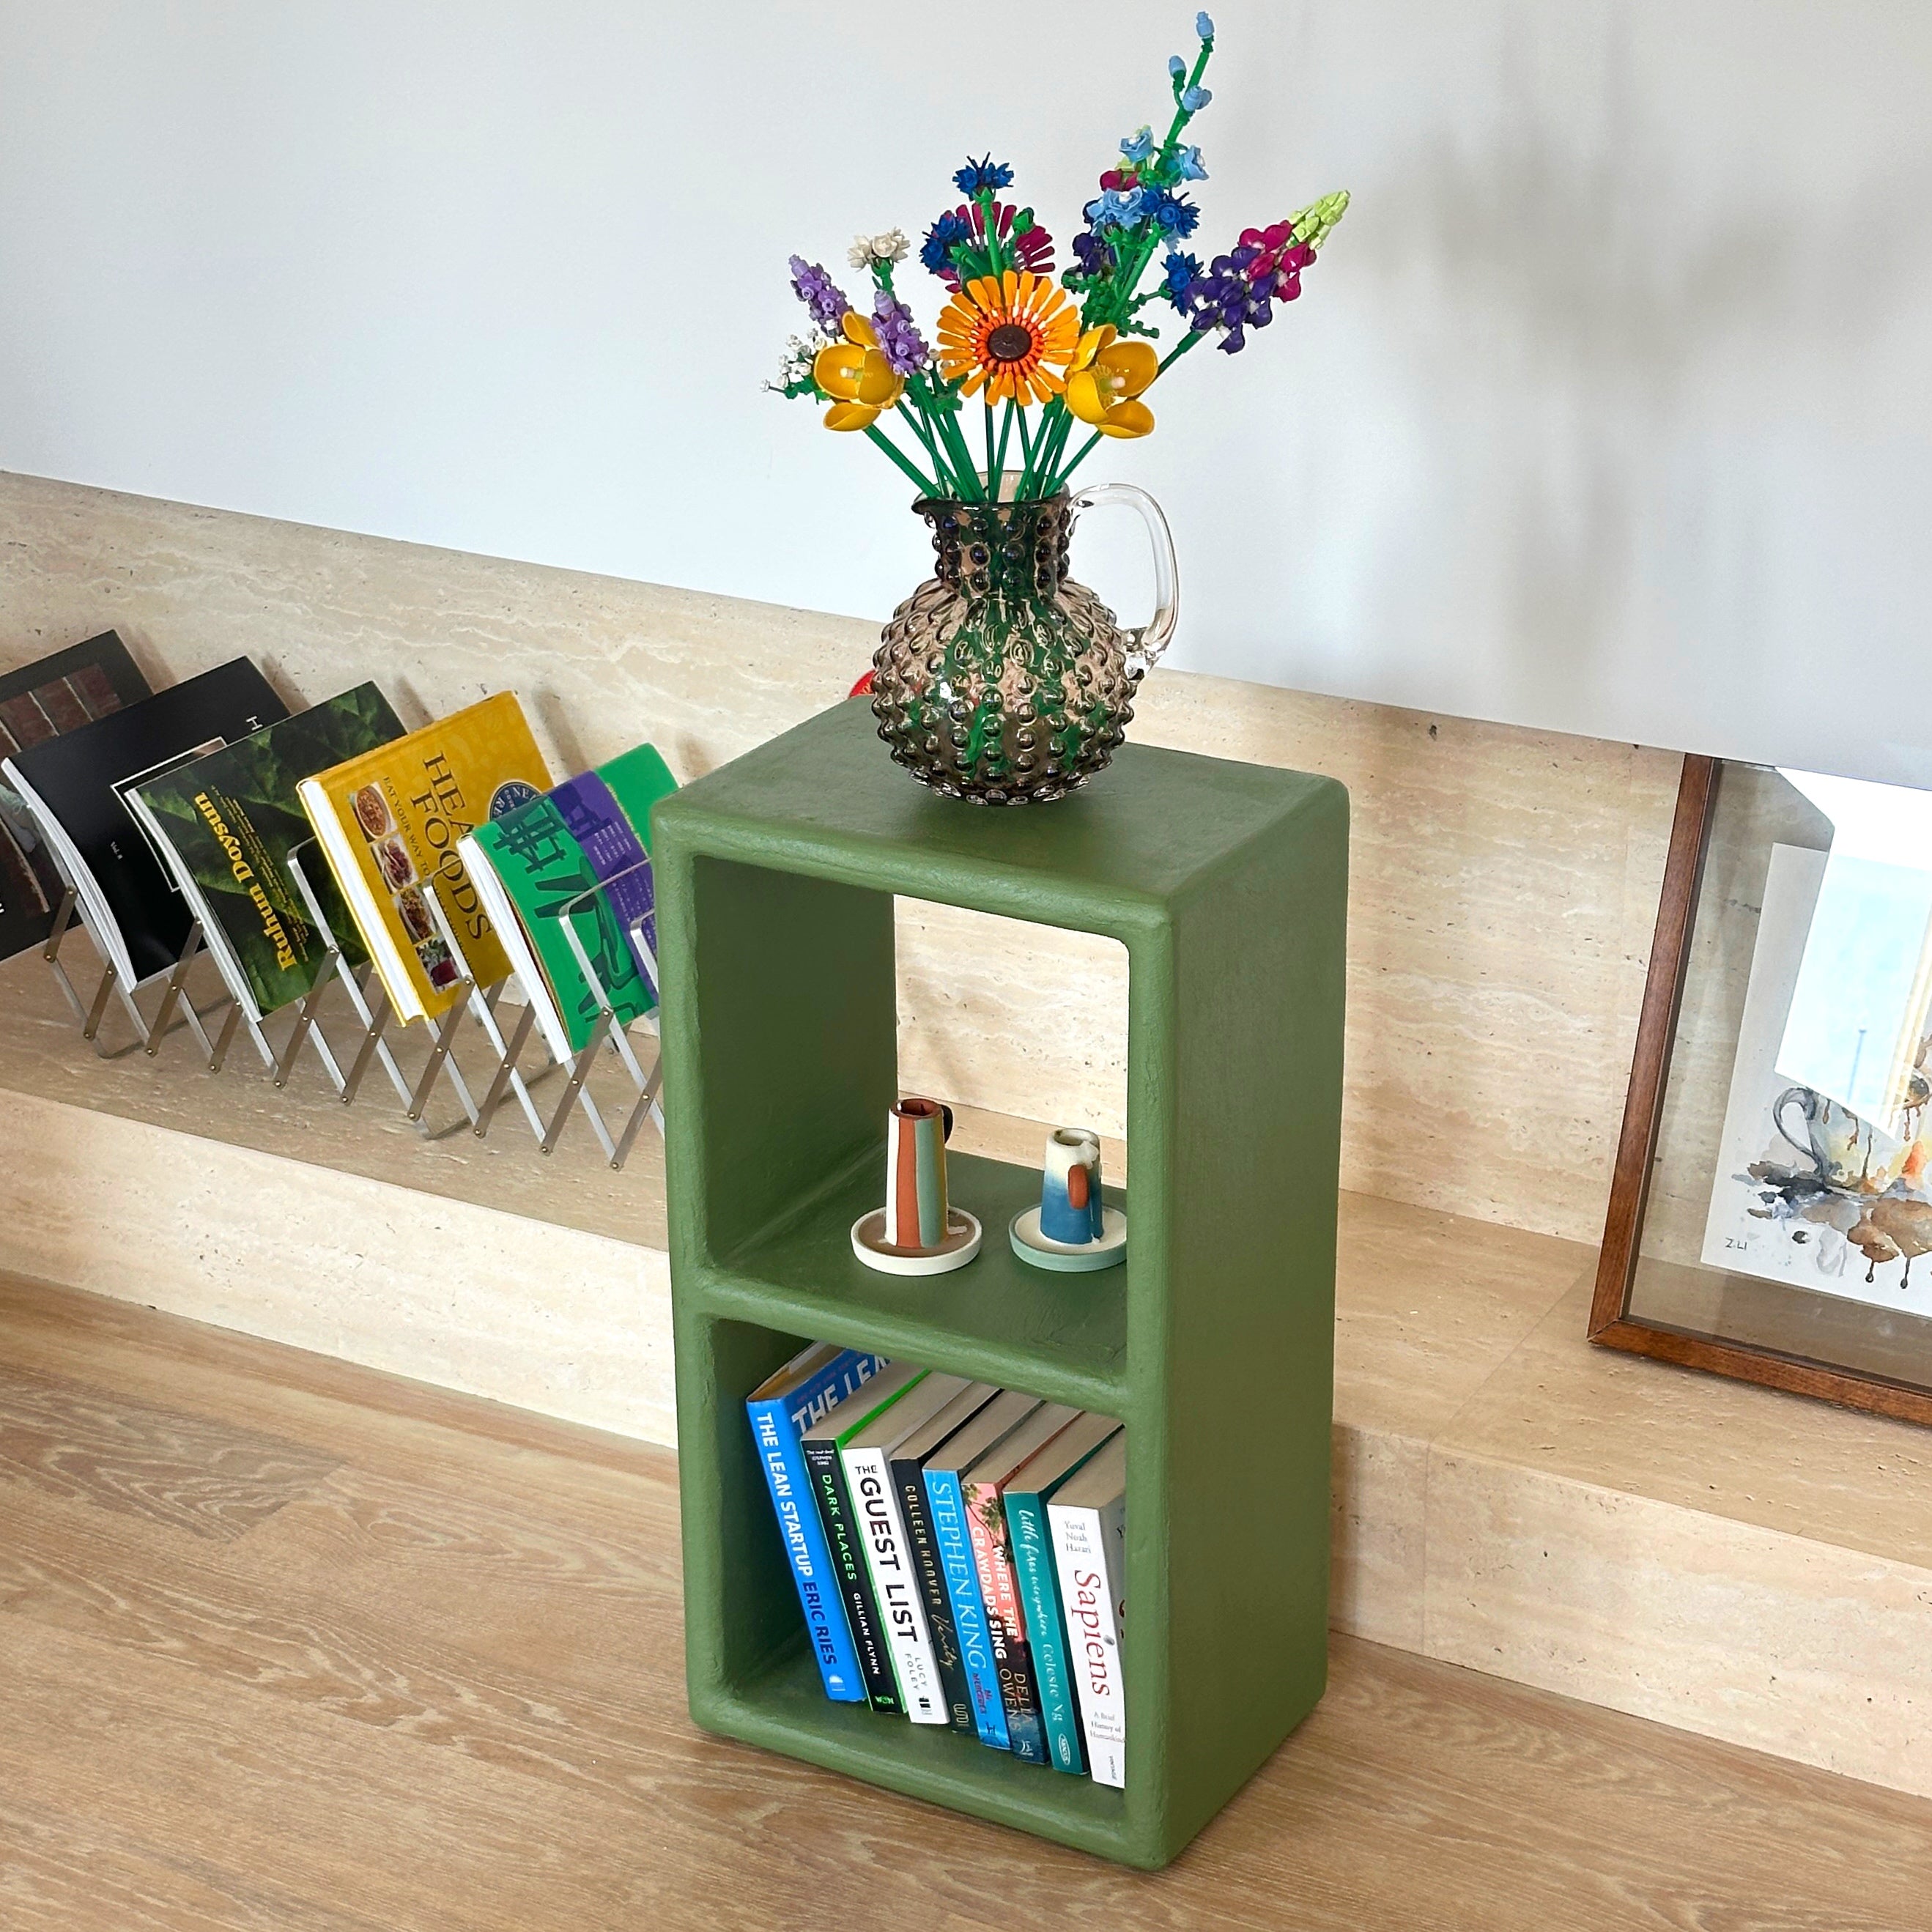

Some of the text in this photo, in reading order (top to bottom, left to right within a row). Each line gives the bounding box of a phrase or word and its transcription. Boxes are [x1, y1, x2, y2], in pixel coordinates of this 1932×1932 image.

[195, 792, 254, 884] Doysun
[396, 799, 411, 832] YOUR
[410, 833, 423, 857] WAY
[421, 859, 430, 876] TO
[410, 788, 491, 940] FOODS
[250, 882, 297, 971] Ruhun
[791, 1383, 840, 1434] THE
[854, 1465, 878, 1475] THE
[757, 1412, 837, 1665] THE LEAN STARTUP ERIC RIES
[860, 1477, 919, 1643] GUEST LIST
[1064, 1520, 1086, 1531] Yuval
[1065, 1532, 1088, 1543] Noah
[1066, 1544, 1092, 1554] Harari
[822, 1474, 881, 1675] DARK PLACES GILLIAN FLYNN
[905, 1484, 958, 1670] COLLEEN HOOVER Verity
[933, 1481, 987, 1670] STEPHEN KING
[971, 1526, 1007, 1659] CRAWDADS SING
[992, 1545, 1019, 1637] WHERE THE
[904, 1653, 919, 1691] FOLEY
[915, 1657, 927, 1687] LUCY
[1071, 1569, 1110, 1697] Sapiens
[999, 1668, 1021, 1731] OWENS
[1014, 1673, 1032, 1722] DELIA
[1043, 1643, 1059, 1698] Celeste
[1051, 1704, 1064, 1722] Ng
